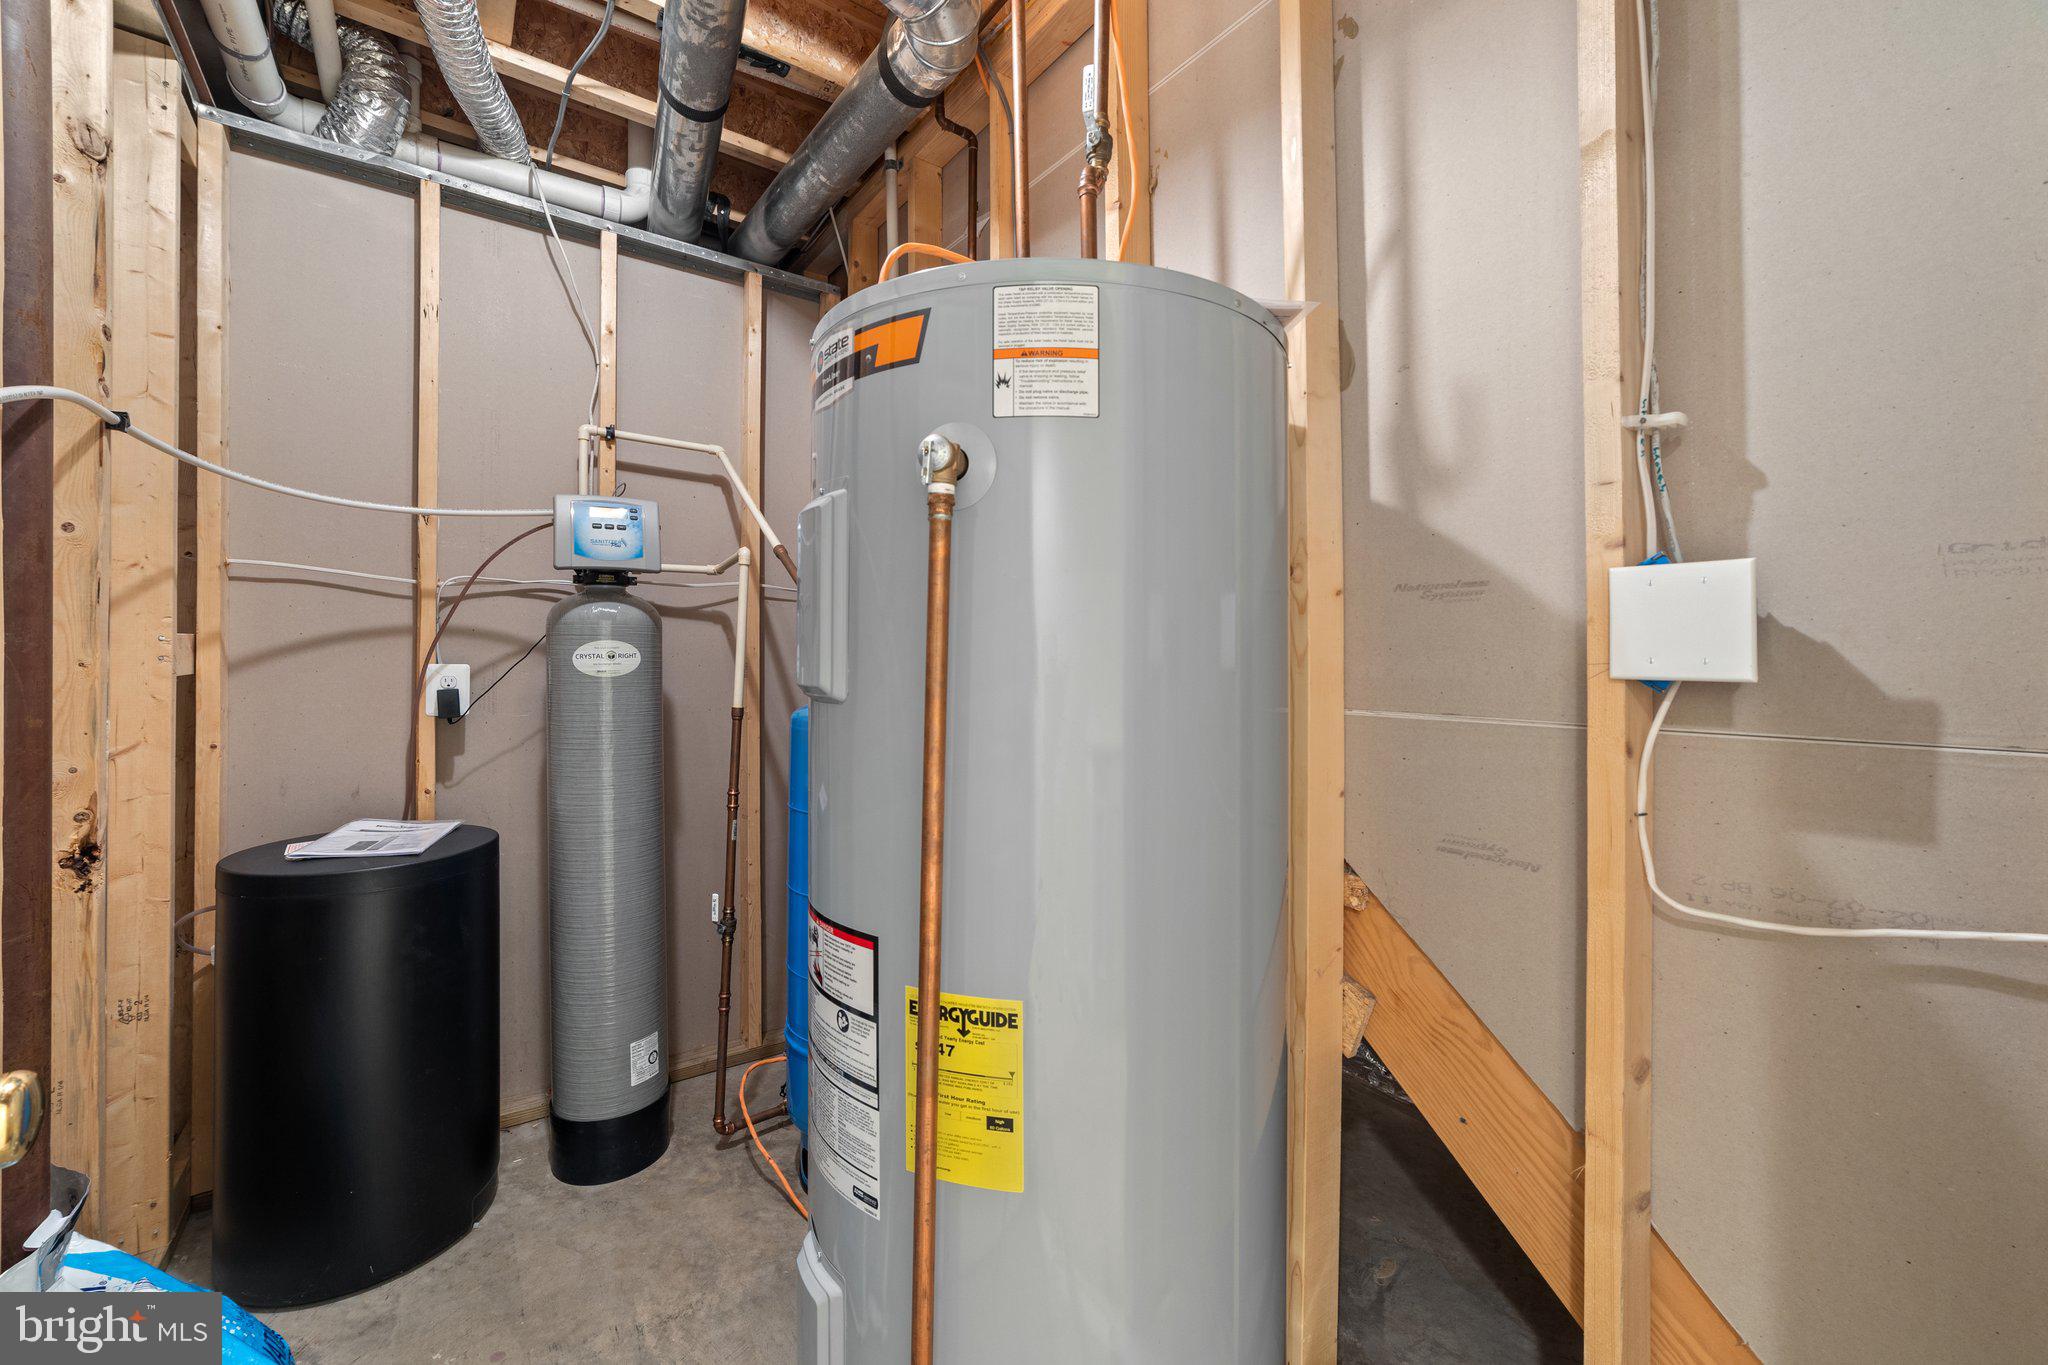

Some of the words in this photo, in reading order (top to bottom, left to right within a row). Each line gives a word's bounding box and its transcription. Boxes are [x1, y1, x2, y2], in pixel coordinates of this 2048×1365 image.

[824, 335, 849, 360] state
[909, 999, 1018, 1029] ERGYGUIDE
[959, 1037, 973, 1045] Energy
[966, 1097, 986, 1105] Rating
